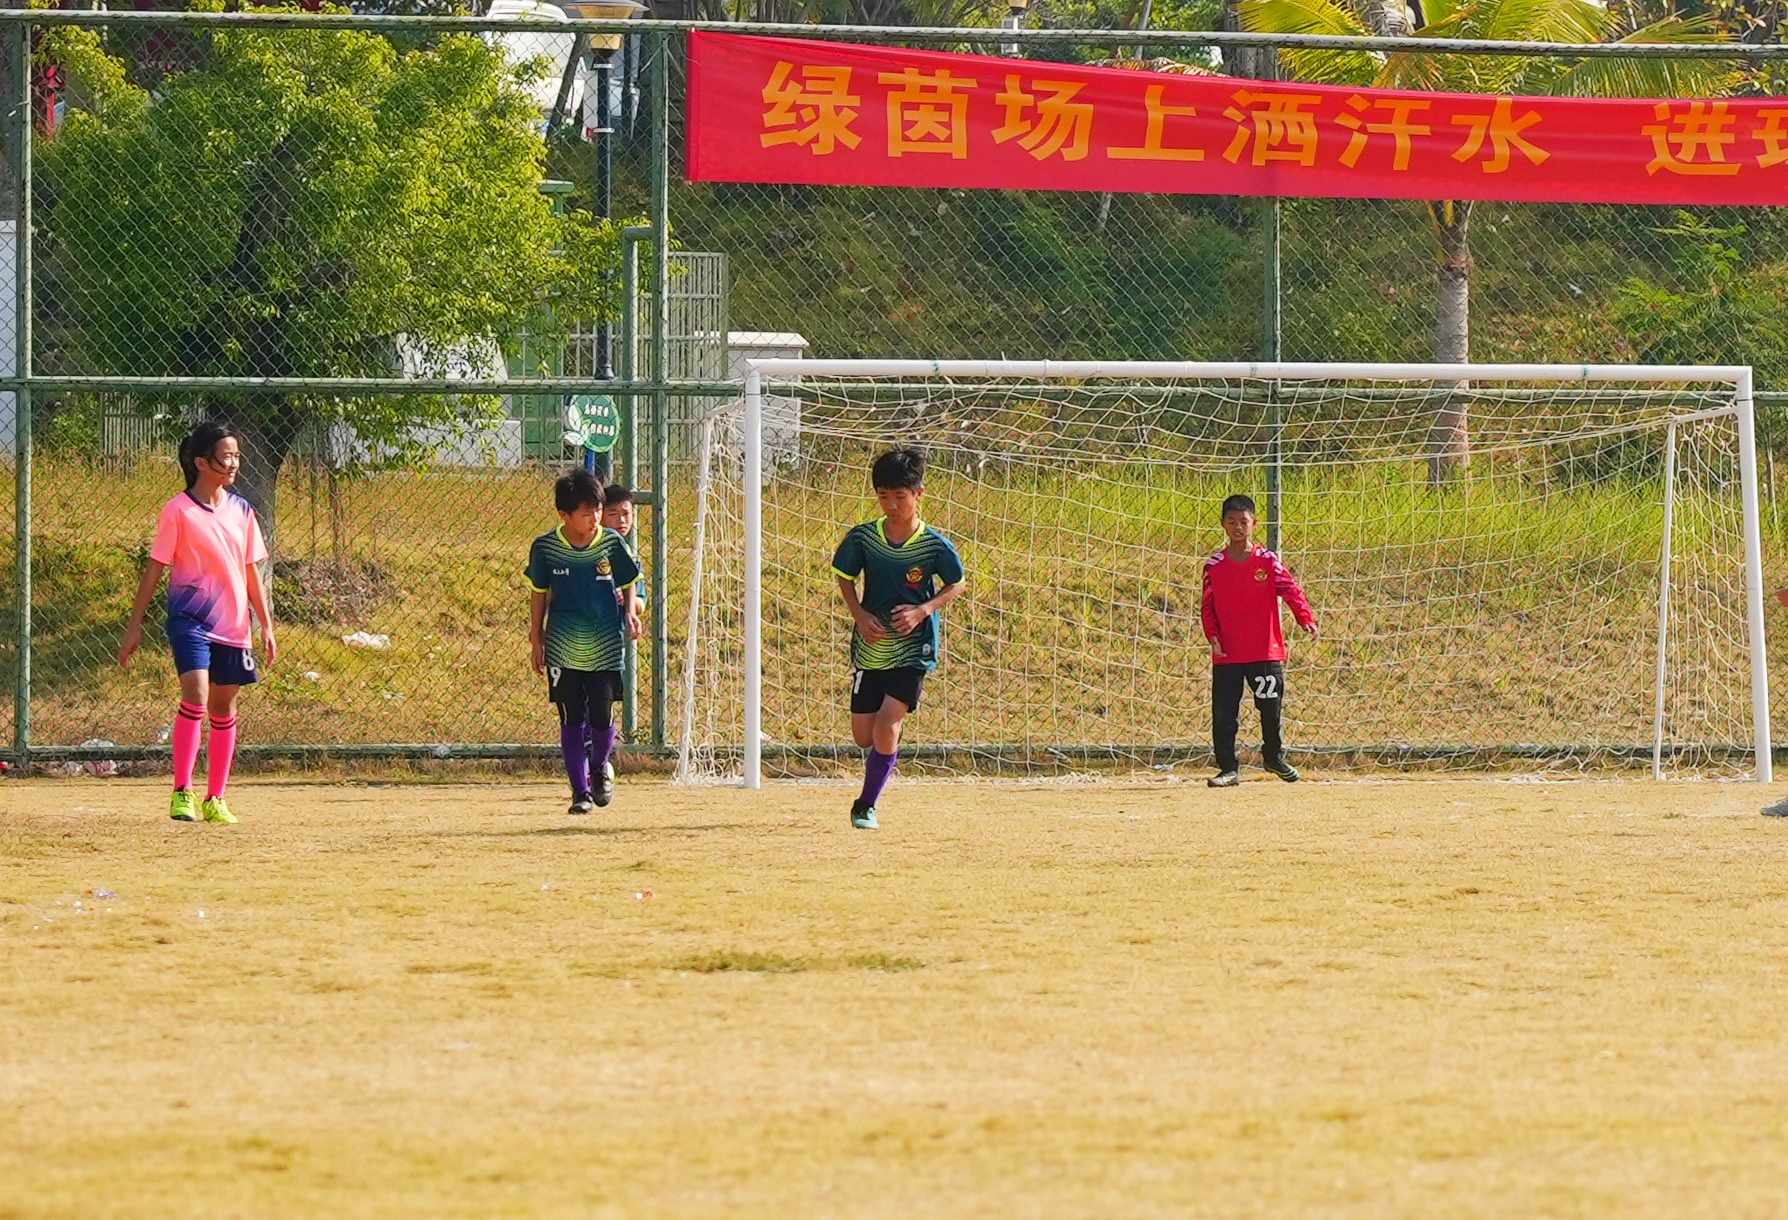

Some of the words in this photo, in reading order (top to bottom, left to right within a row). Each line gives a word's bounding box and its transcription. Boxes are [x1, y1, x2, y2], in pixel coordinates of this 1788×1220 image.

[760, 60, 1551, 174] 绿茵场上洒汗水
[242, 649, 255, 671] 8
[1254, 674, 1279, 699] 22
